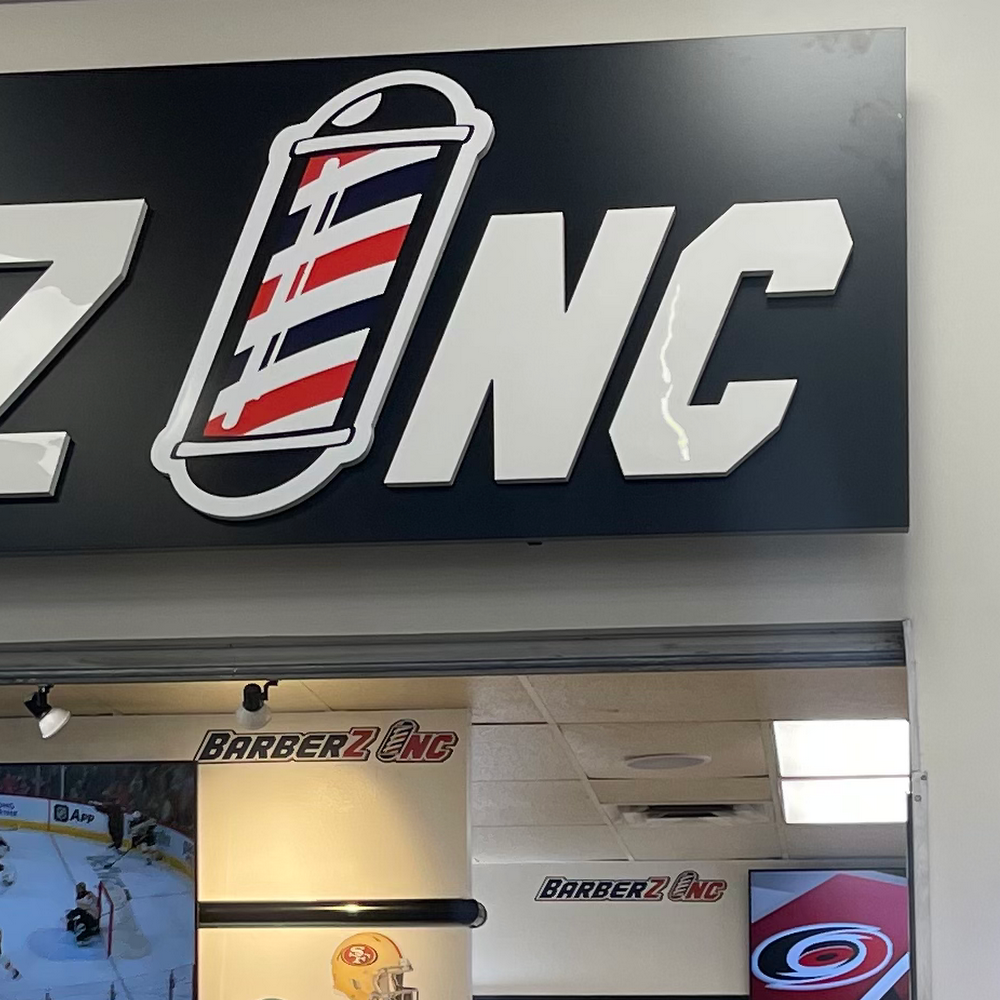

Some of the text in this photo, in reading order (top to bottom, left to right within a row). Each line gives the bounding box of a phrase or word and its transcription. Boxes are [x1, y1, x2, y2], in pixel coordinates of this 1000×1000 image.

[199, 728, 377, 760] BARBERZ
[69, 807, 96, 824] App
[539, 877, 669, 900] BARBERZ
